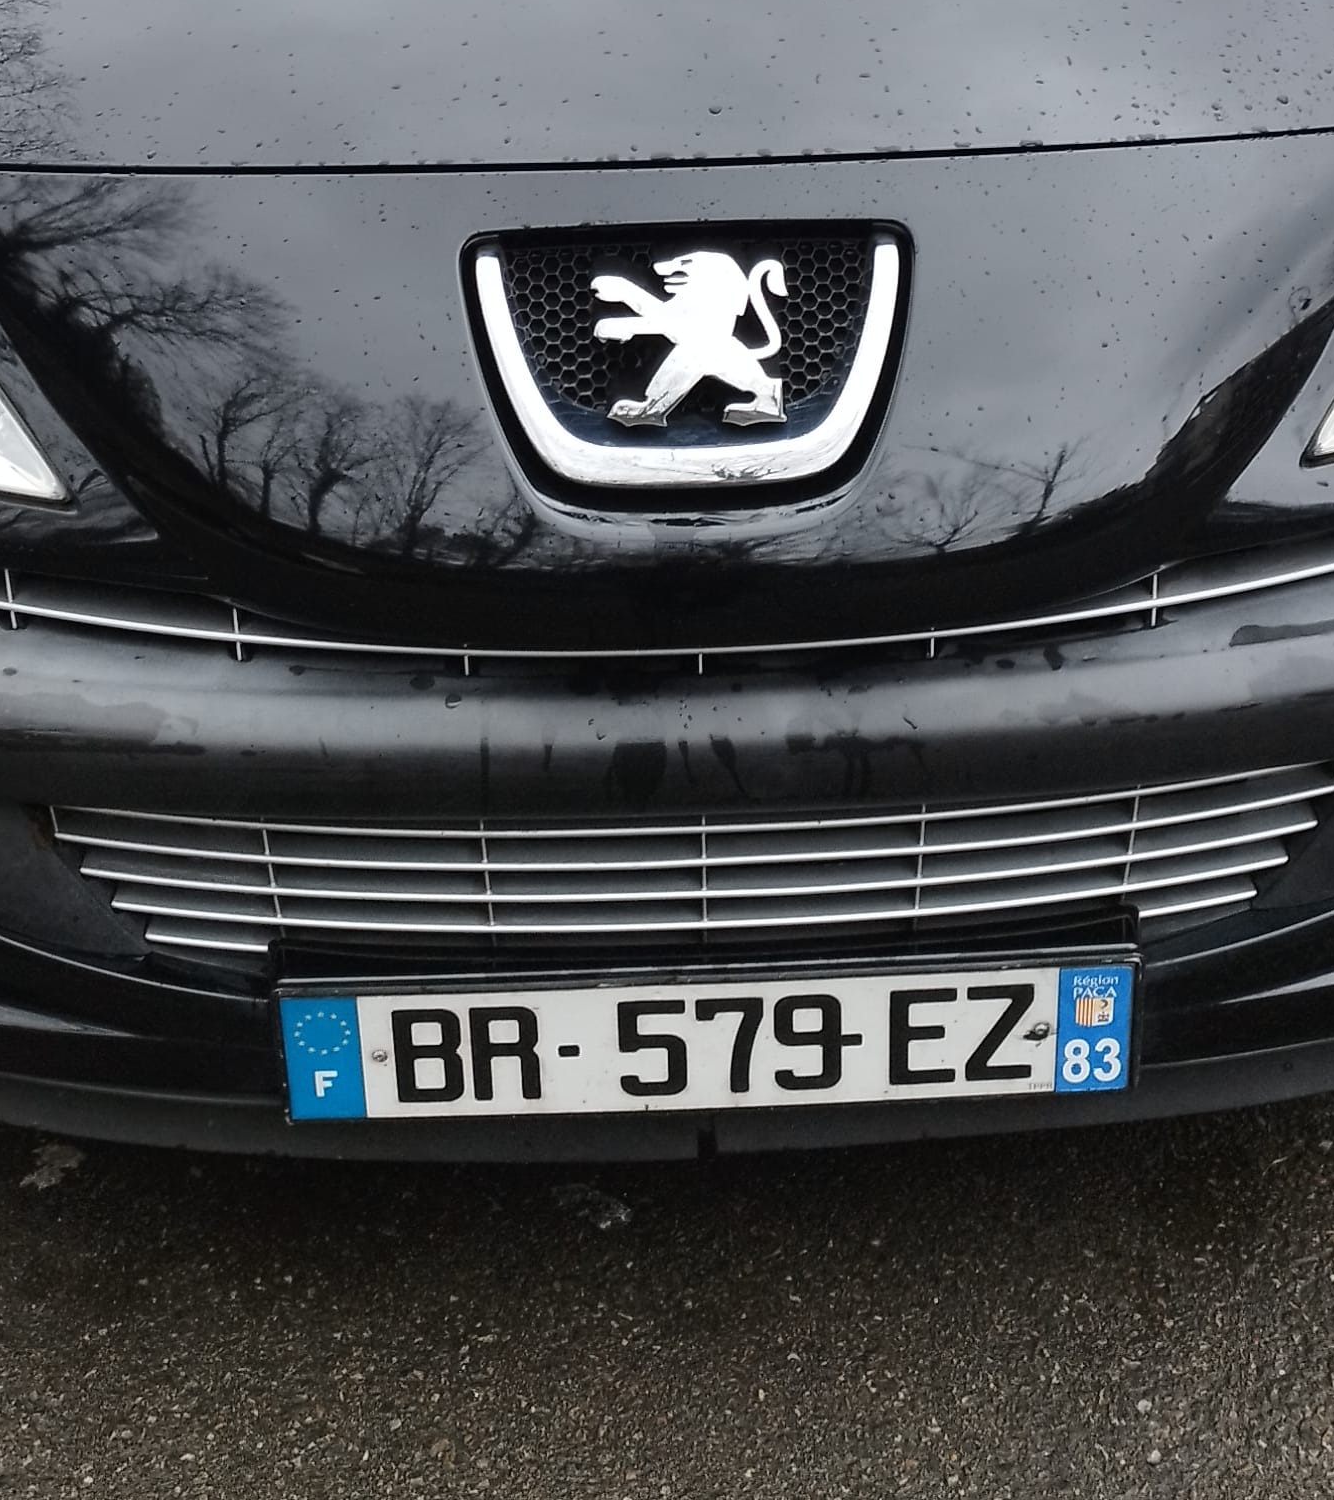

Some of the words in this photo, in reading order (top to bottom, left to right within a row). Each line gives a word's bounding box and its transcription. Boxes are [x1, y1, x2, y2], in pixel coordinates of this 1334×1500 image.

[1073, 975, 1119, 987] Région
[1073, 986, 1118, 998] PACA
[1062, 1037, 1122, 1083] 83
[314, 1070, 338, 1098] F
